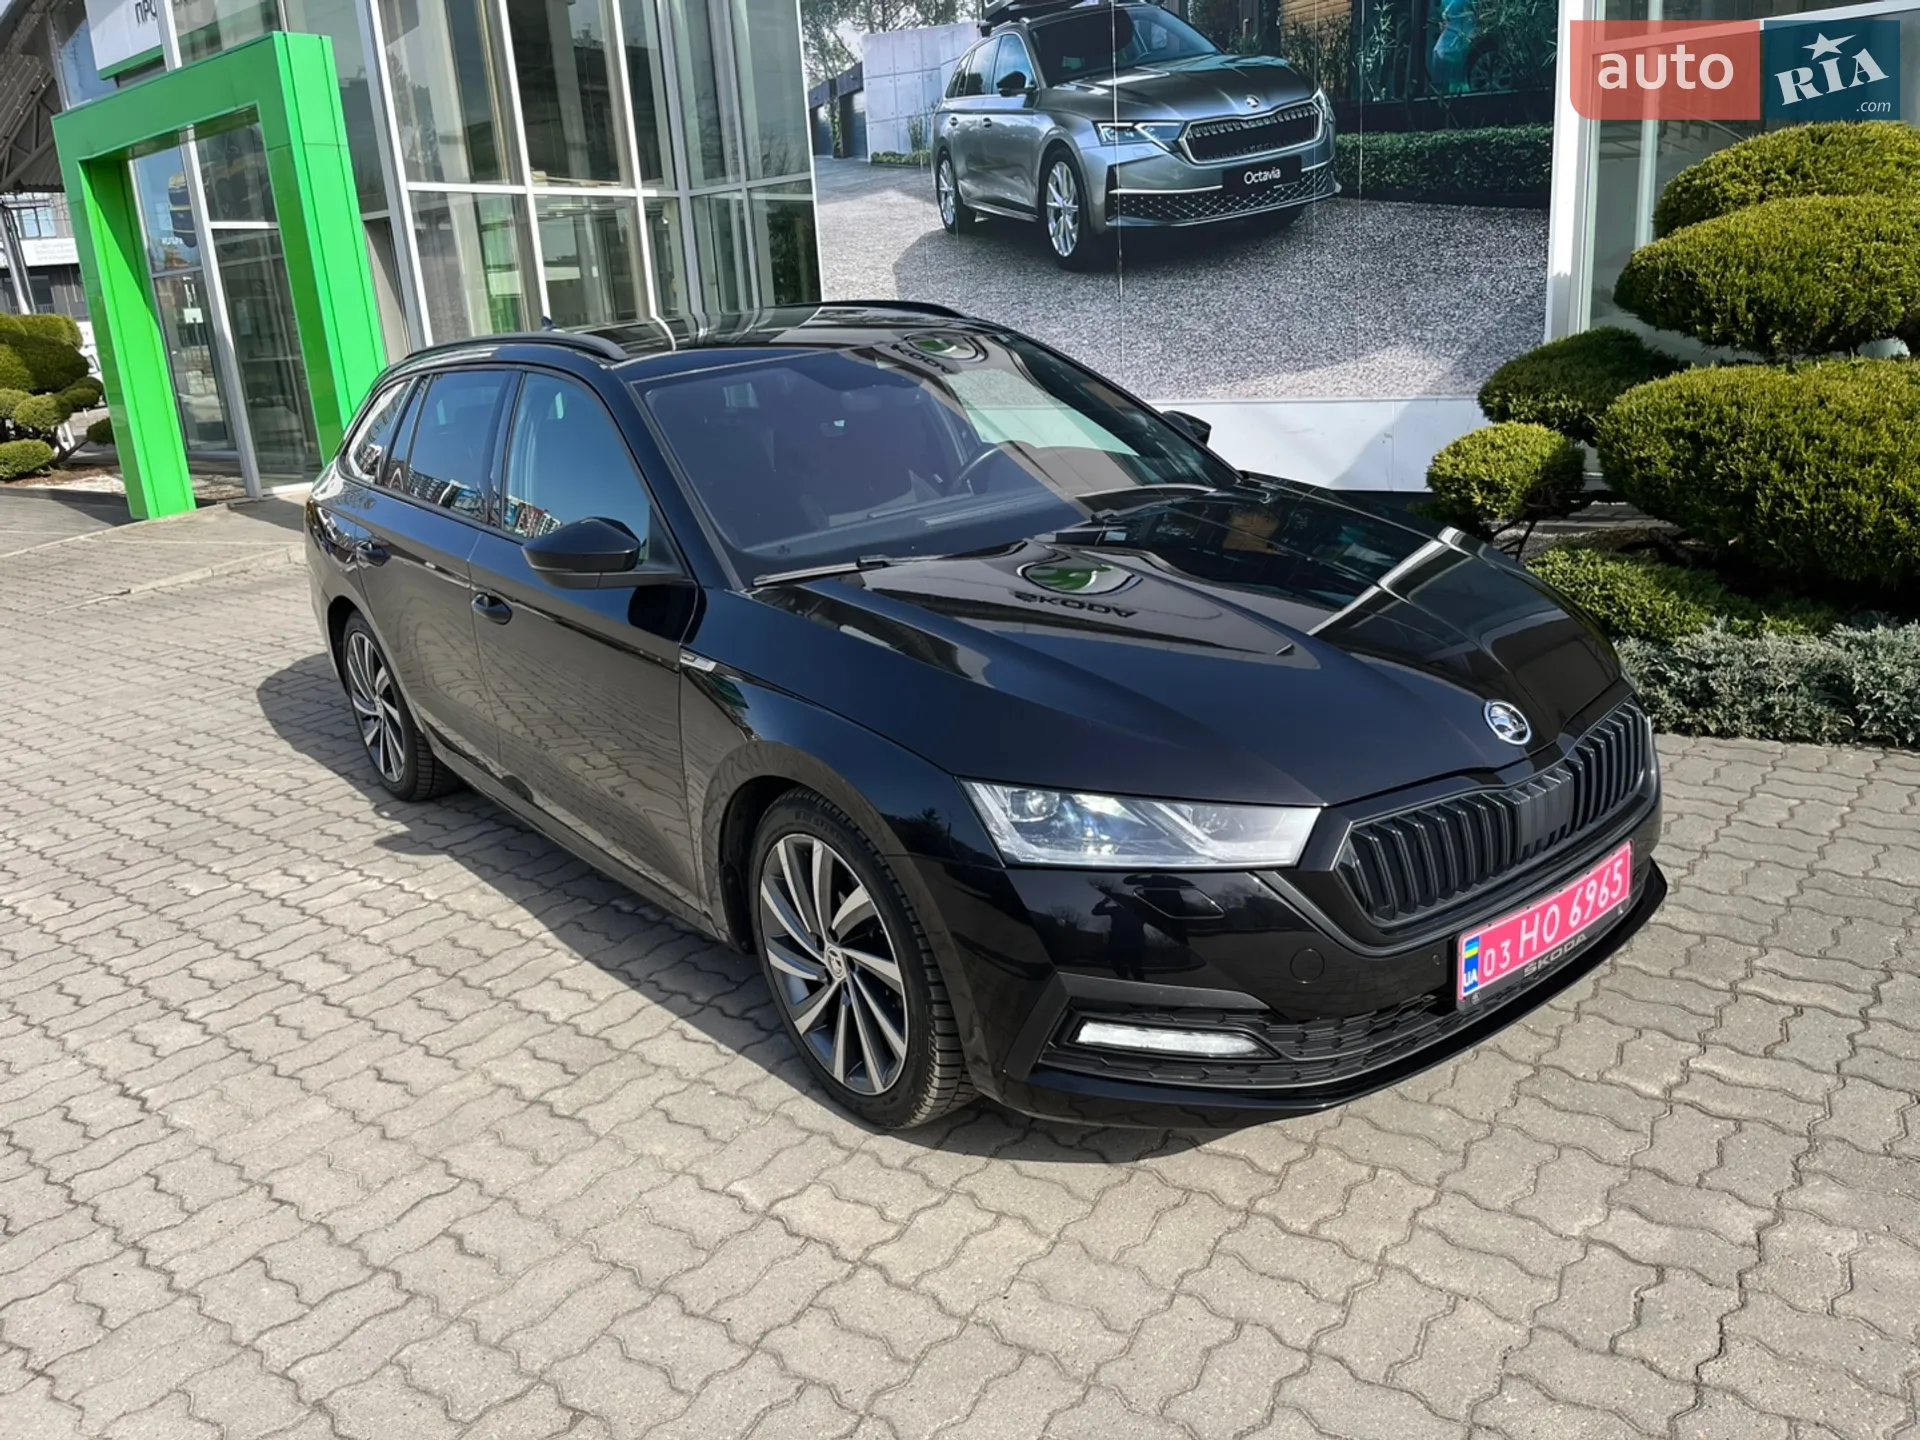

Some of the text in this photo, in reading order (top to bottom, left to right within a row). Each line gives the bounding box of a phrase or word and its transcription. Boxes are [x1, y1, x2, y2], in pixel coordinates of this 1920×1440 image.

[1244, 167, 1281, 185] Octavia
[1483, 858, 1624, 977] 03 HO 6965
[1464, 968, 1478, 987] UA
